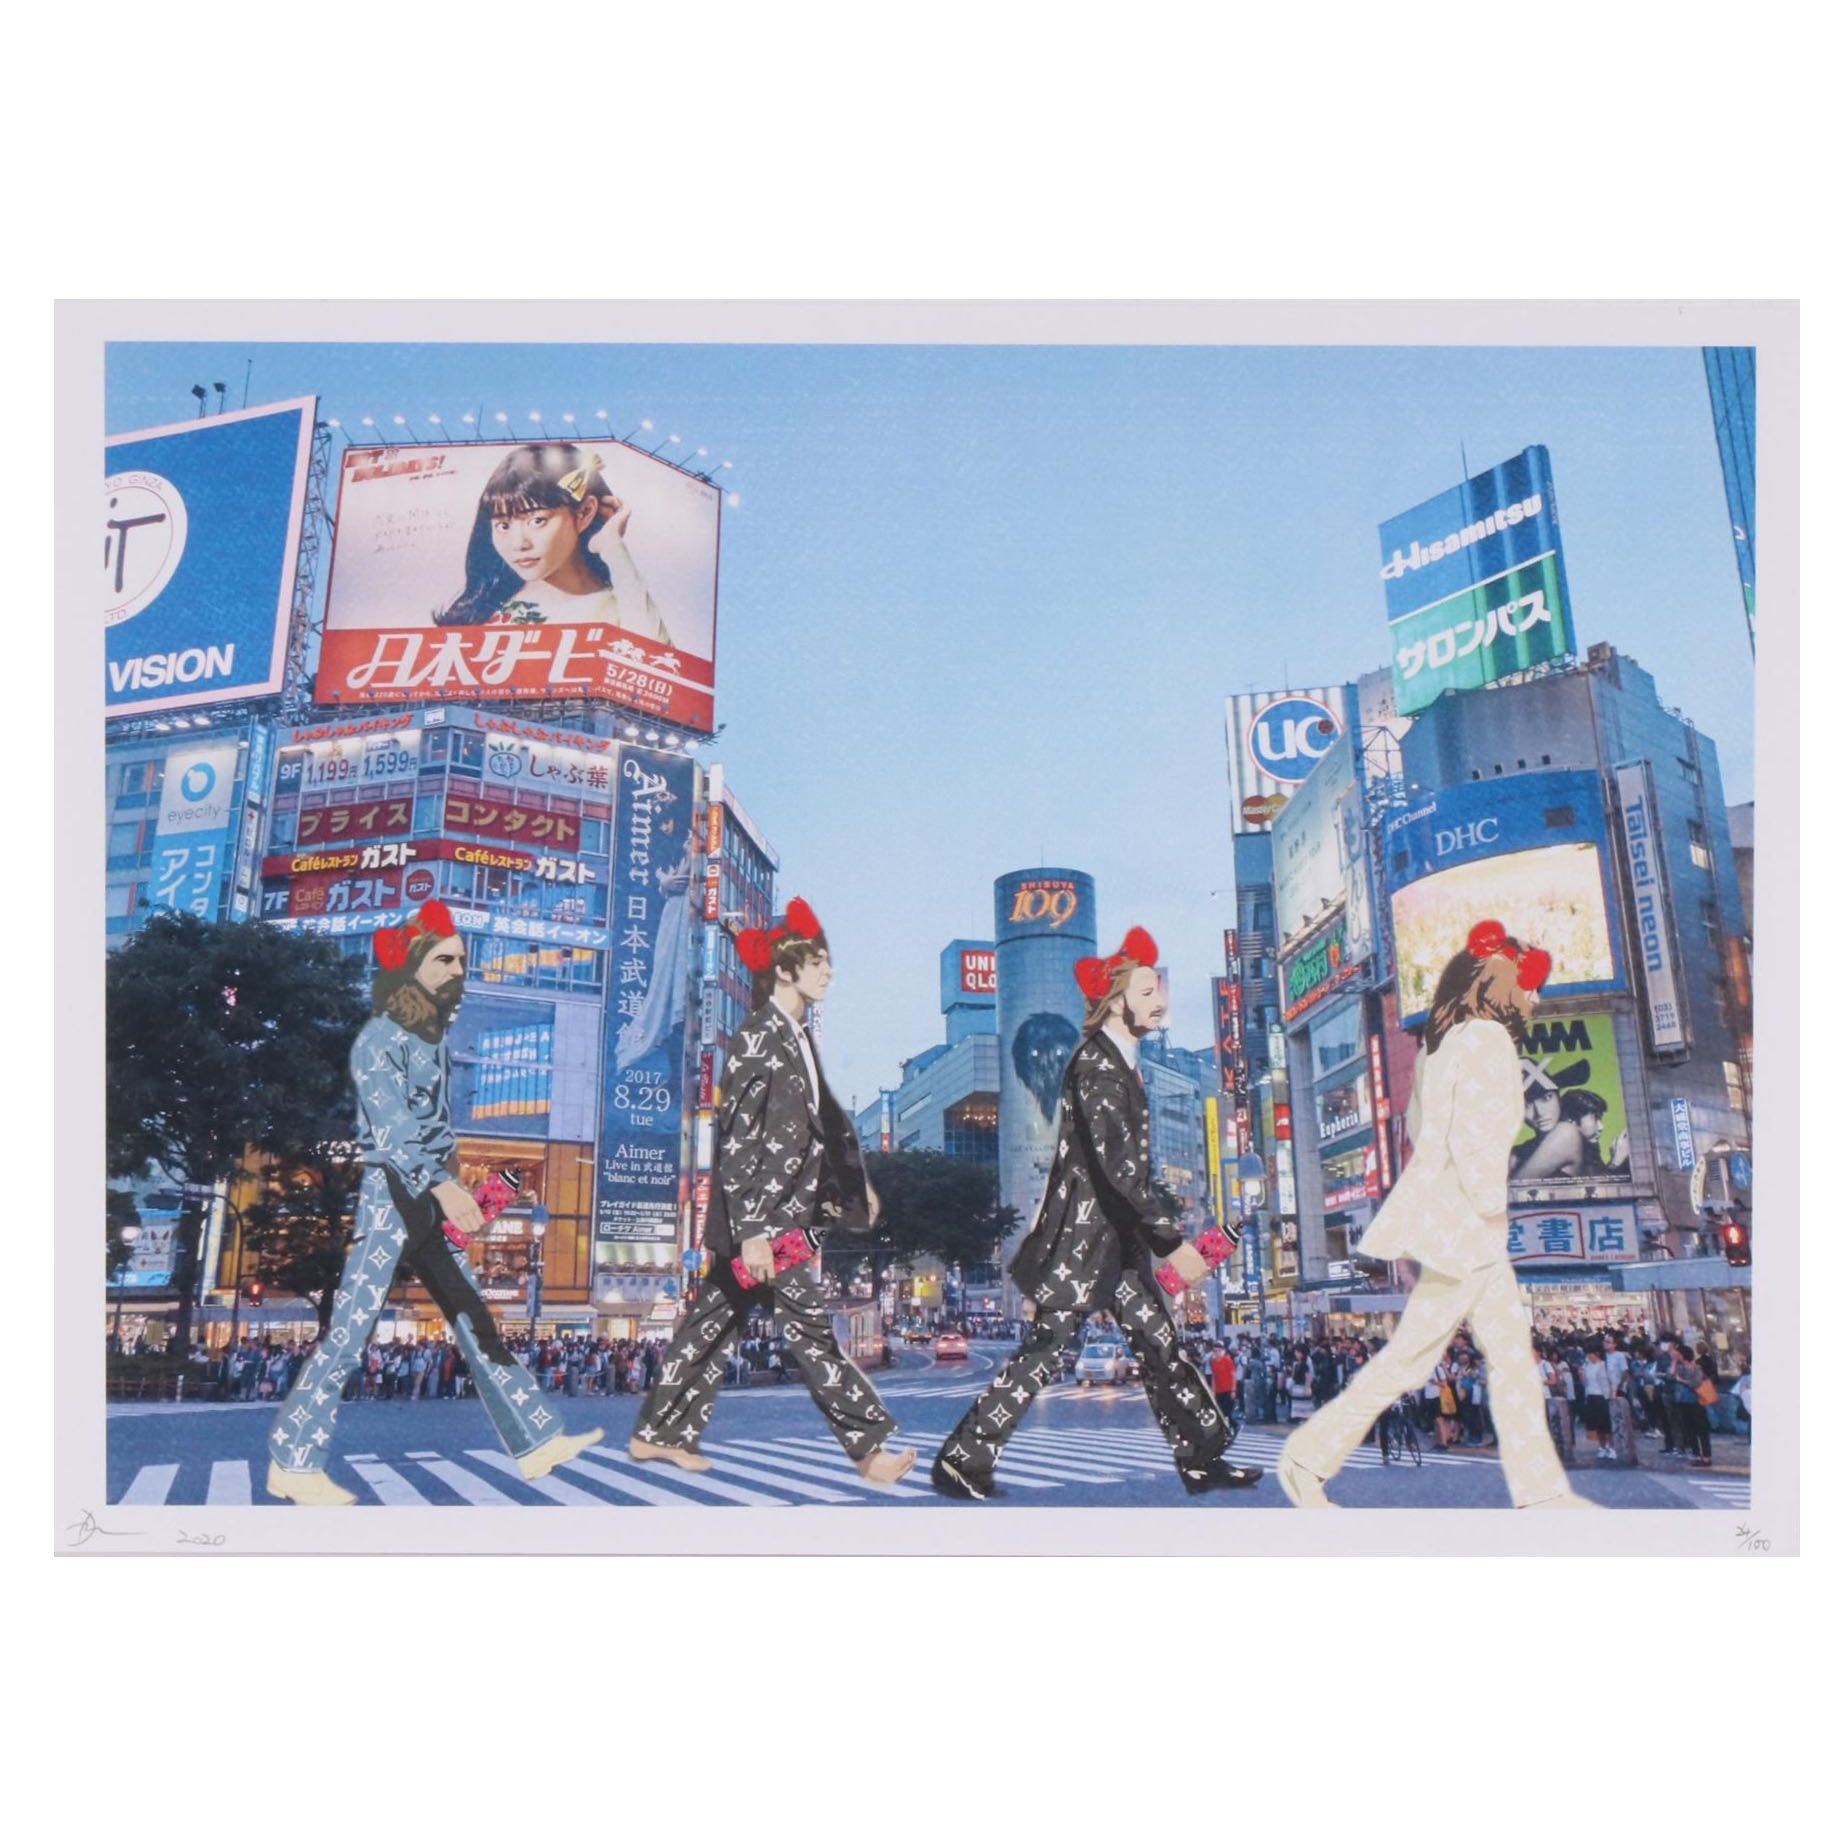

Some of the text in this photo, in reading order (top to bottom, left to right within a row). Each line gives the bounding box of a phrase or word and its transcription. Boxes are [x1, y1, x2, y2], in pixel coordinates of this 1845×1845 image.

[1379, 494, 1543, 581] Hisamitsu
[1396, 590, 1552, 680] サロンパス
[108, 643, 236, 692] VISION
[606, 663, 673, 697] 5/28(日)
[280, 763, 302, 780] 9F
[529, 753, 609, 790] しゃぶ葉
[167, 804, 222, 824] eyecity
[300, 803, 409, 837] プライス
[445, 799, 577, 842] コンタクト
[1433, 817, 1499, 857] DHC
[360, 843, 416, 870] ガスト
[535, 855, 596, 884] ガスト
[263, 891, 290, 911] 7F
[325, 878, 396, 913] ガスト
[408, 883, 432, 893] ガスト
[1008, 888, 1078, 928] 109
[493, 915, 607, 945] 英会話イーオン
[1637, 890, 1663, 972] neon
[625, 1069, 662, 1085] 2017
[614, 1084, 671, 1112] 8.29
[630, 1112, 654, 1126] tue
[605, 1159, 628, 1171] Live
[630, 1160, 641, 1171] in
[615, 1143, 666, 1161] Aimer
[638, 1174, 649, 1185] et
